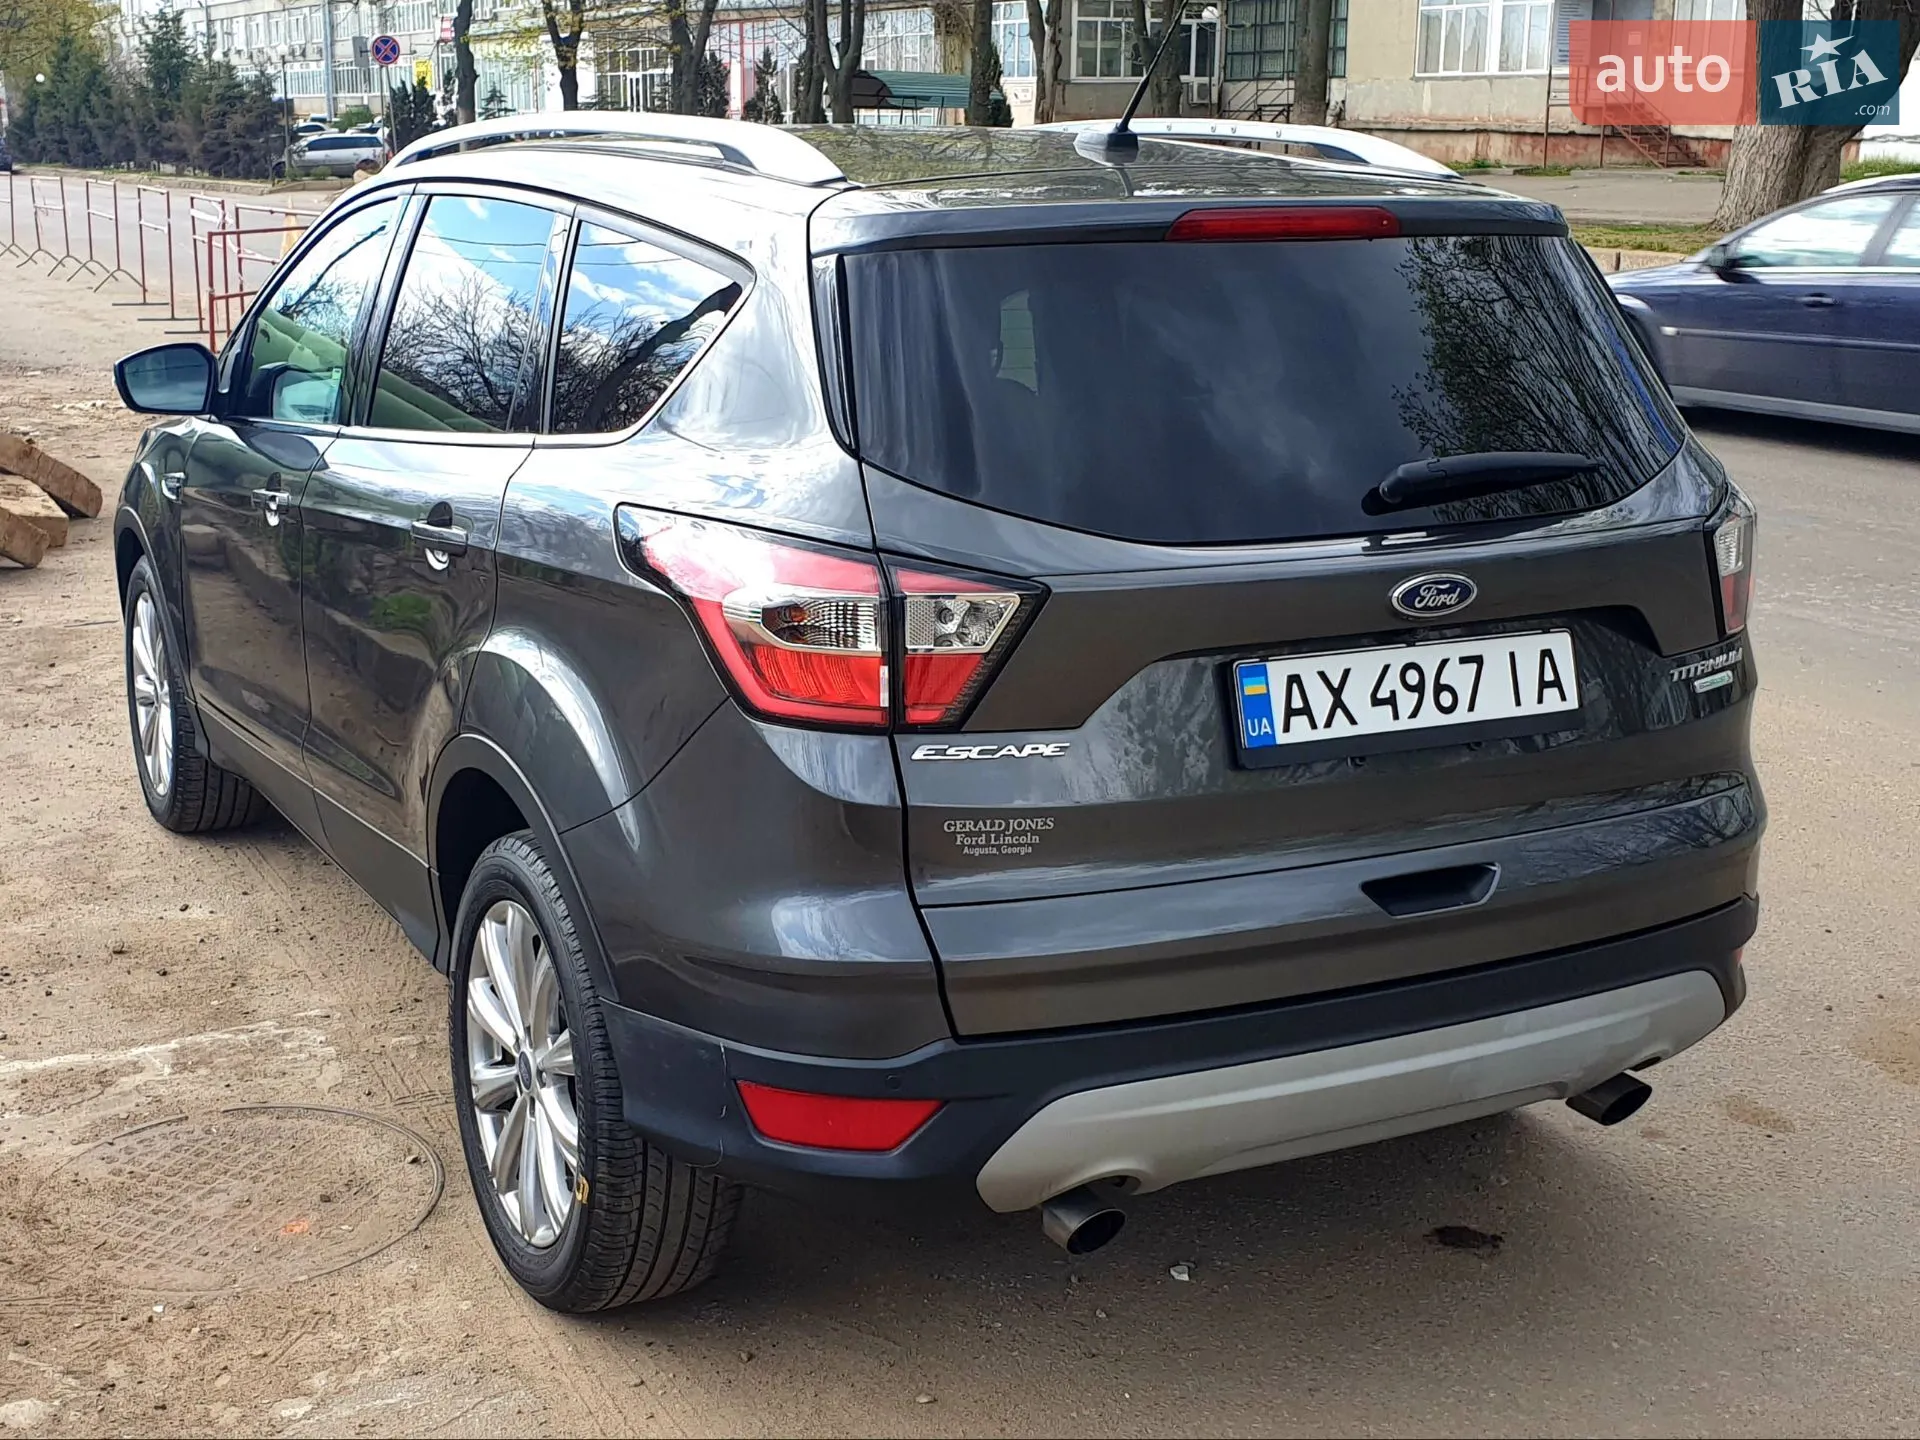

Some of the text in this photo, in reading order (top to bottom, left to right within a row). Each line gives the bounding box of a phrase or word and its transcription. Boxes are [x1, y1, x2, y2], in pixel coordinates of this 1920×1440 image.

[1415, 584, 1460, 608] Ford
[1282, 648, 1568, 733] AX 4967 IA
[1247, 717, 1272, 737] UA
[911, 742, 1070, 760] ESCAPE
[943, 817, 1055, 834] GERALD JONES
[955, 832, 1040, 845] Ford Lincoln
[963, 845, 1032, 856] Augusta, Georgia
